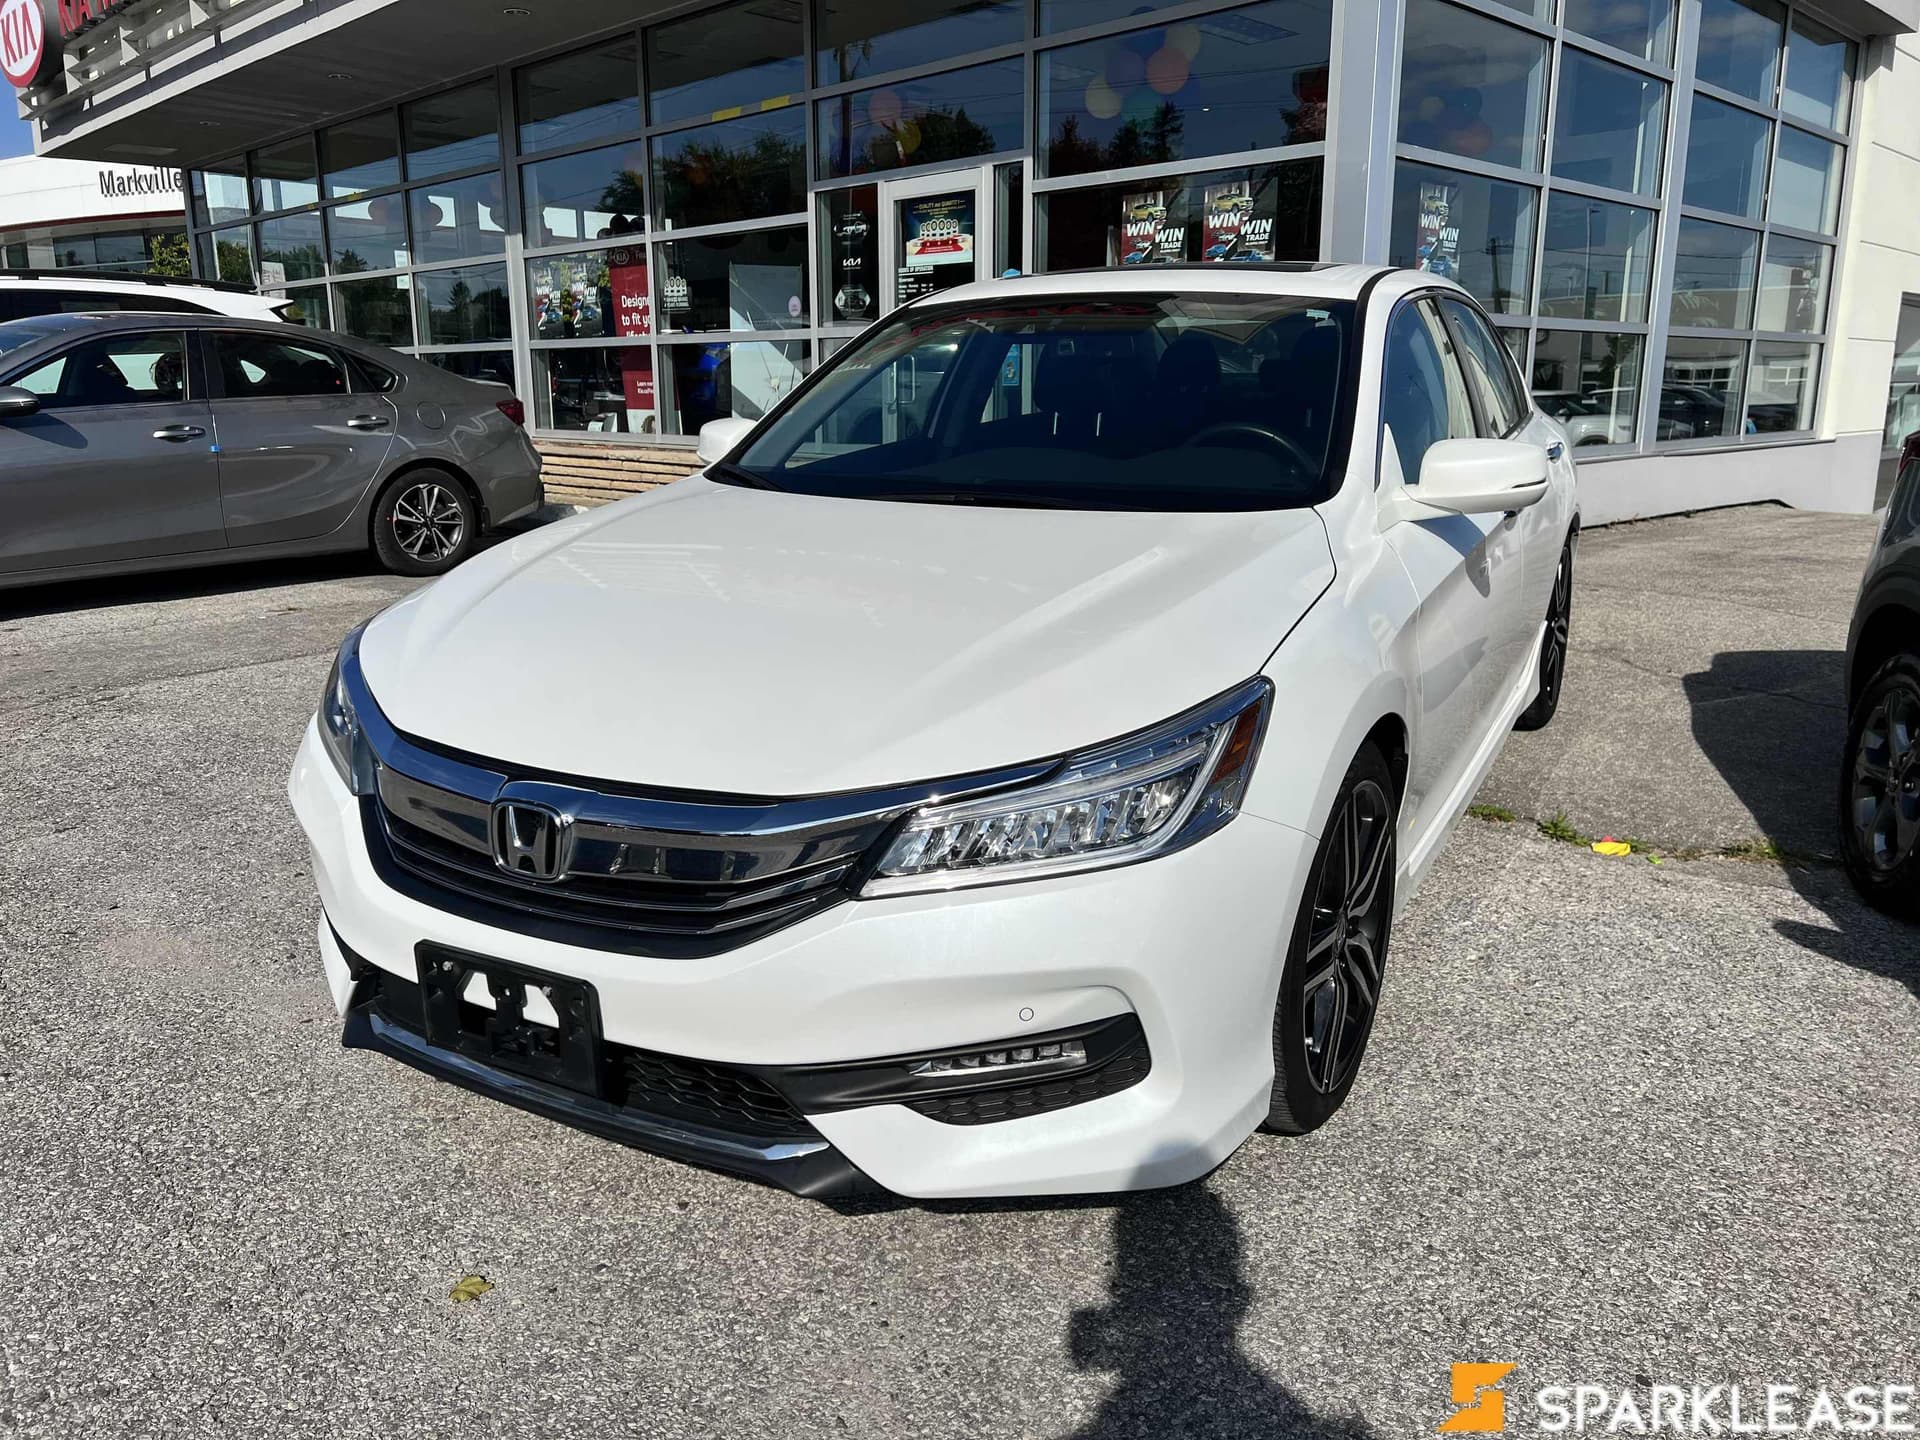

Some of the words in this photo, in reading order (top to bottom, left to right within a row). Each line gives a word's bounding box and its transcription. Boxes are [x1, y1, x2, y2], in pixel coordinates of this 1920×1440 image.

[1, 2, 37, 67] KIA
[99, 165, 184, 194] Markville
[1126, 221, 1155, 237] WIN
[1208, 213, 1240, 229] WIN
[1240, 218, 1272, 236] WIN
[1421, 213, 1440, 230] WIN
[1154, 227, 1184, 243] WIN
[1246, 233, 1269, 241] TRADE
[1440, 227, 1459, 241] WIN
[1160, 241, 1182, 249] TRADE
[621, 314, 630, 326] to
[632, 312, 641, 325] fit
